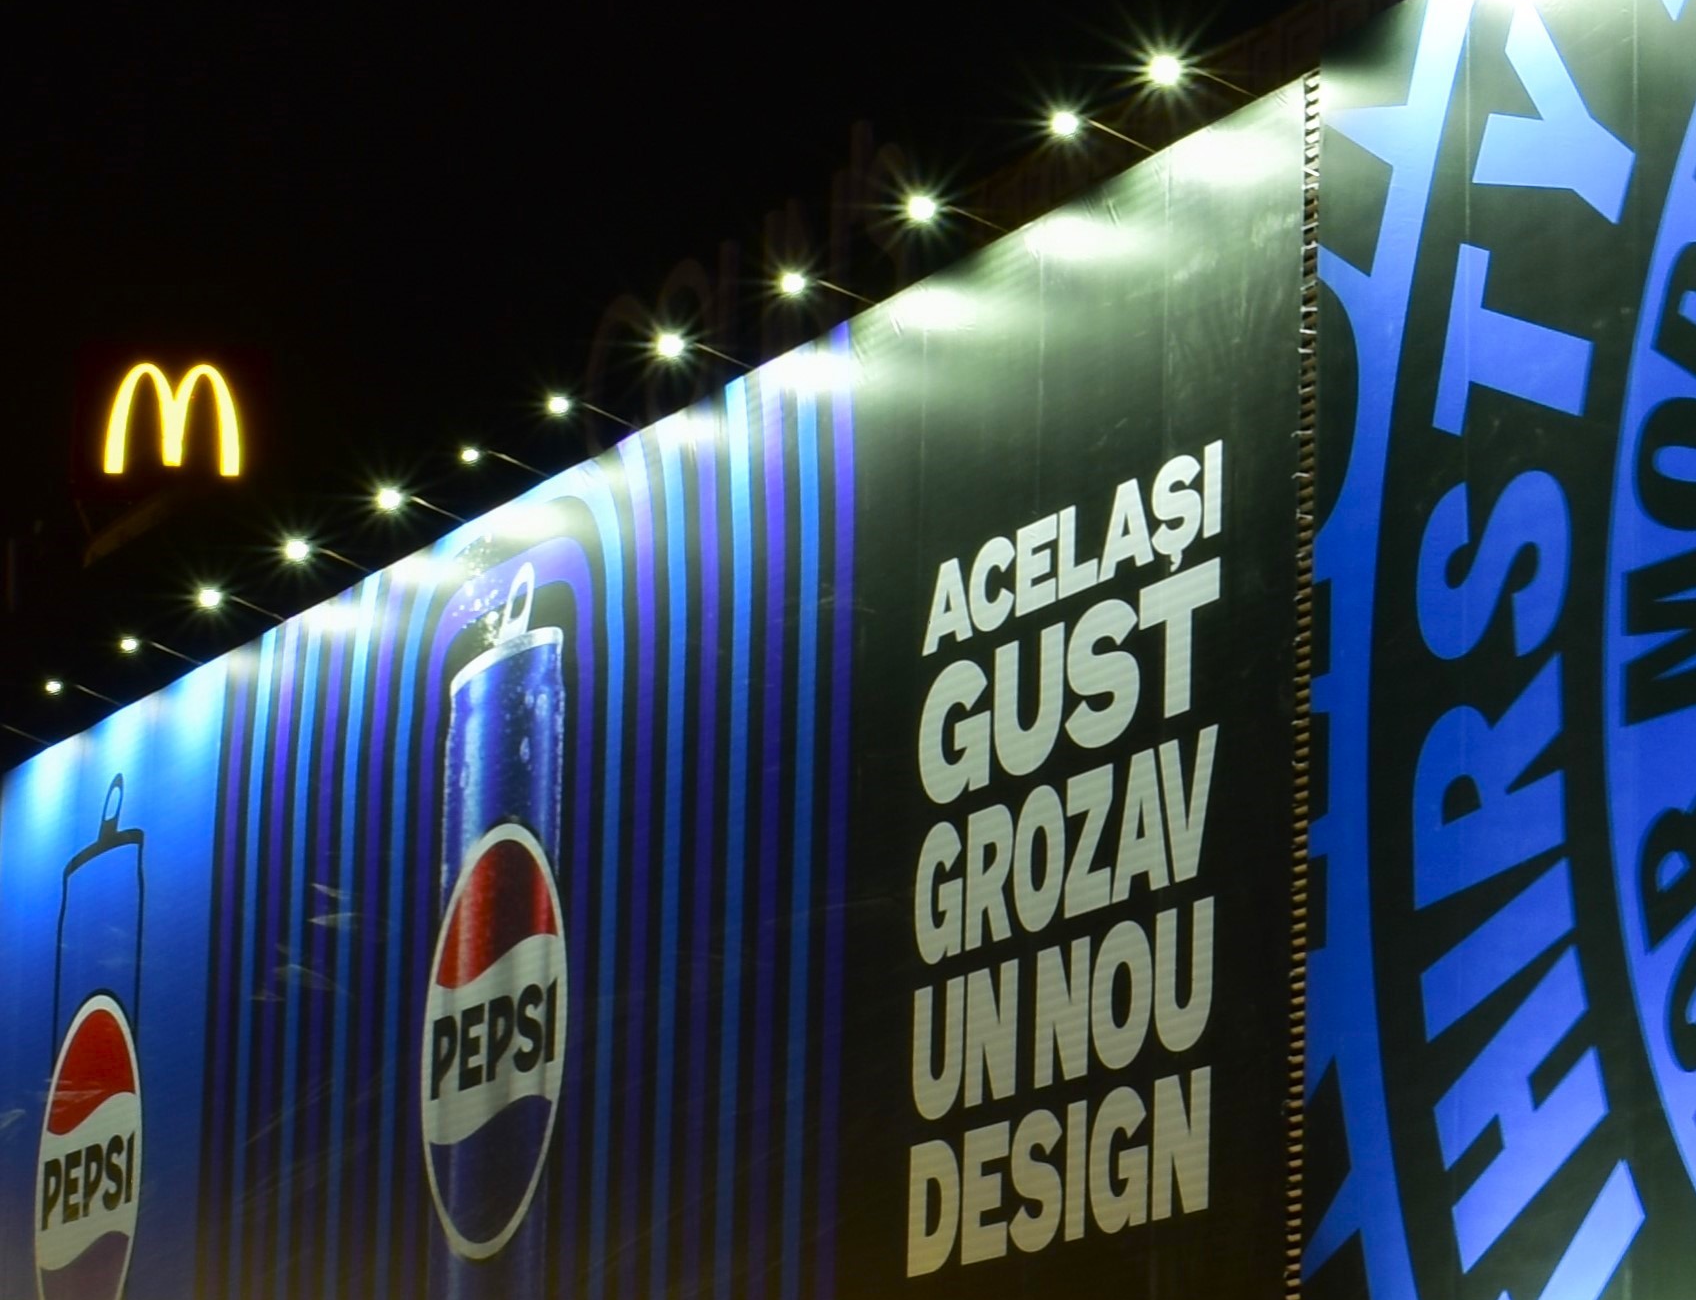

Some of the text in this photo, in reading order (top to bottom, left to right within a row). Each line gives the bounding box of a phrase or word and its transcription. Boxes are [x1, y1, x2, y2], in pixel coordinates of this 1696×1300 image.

[917, 555, 1221, 805] GUST
[914, 722, 1219, 966] GROZAV
[429, 977, 559, 1103] PEPSI
[911, 895, 1215, 1121] UN NOU
[40, 1129, 135, 1234] PEPSI
[906, 1064, 1212, 1278] DESIGN
